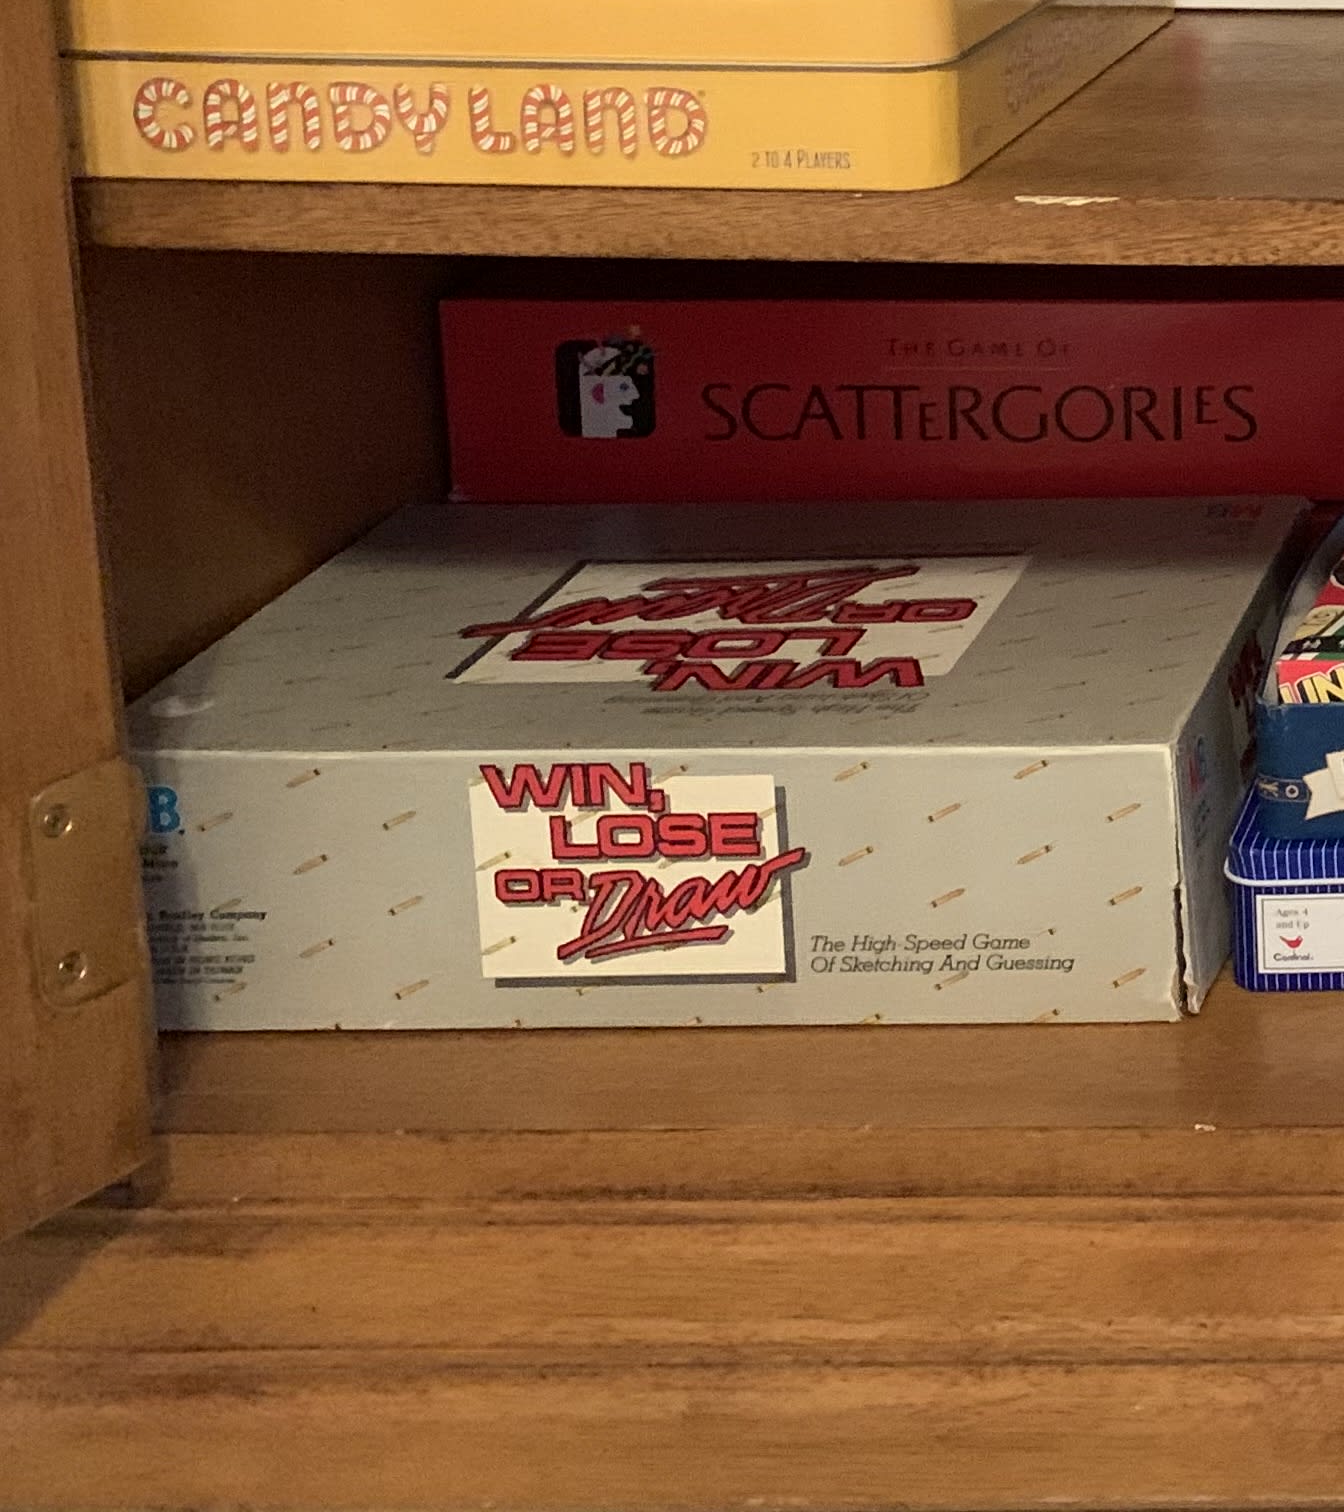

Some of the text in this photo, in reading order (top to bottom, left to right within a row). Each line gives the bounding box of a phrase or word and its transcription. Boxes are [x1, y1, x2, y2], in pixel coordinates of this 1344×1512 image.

[133, 77, 708, 159] CANDY LAND
[751, 151, 852, 171] 2 PLAYERS
[700, 382, 1259, 443] SCATTERGORIES
[509, 627, 868, 662] LOSE
[478, 762, 665, 813] WIN,
[549, 812, 761, 861] LOSE
[209, 909, 267, 921] Company
[494, 847, 806, 961] OR Draw
[1274, 908, 1299, 919] Ages
[1275, 920, 1295, 930] and
[810, 933, 1031, 953] The Game
[810, 954, 1076, 975] Of Sketching And Guessing
